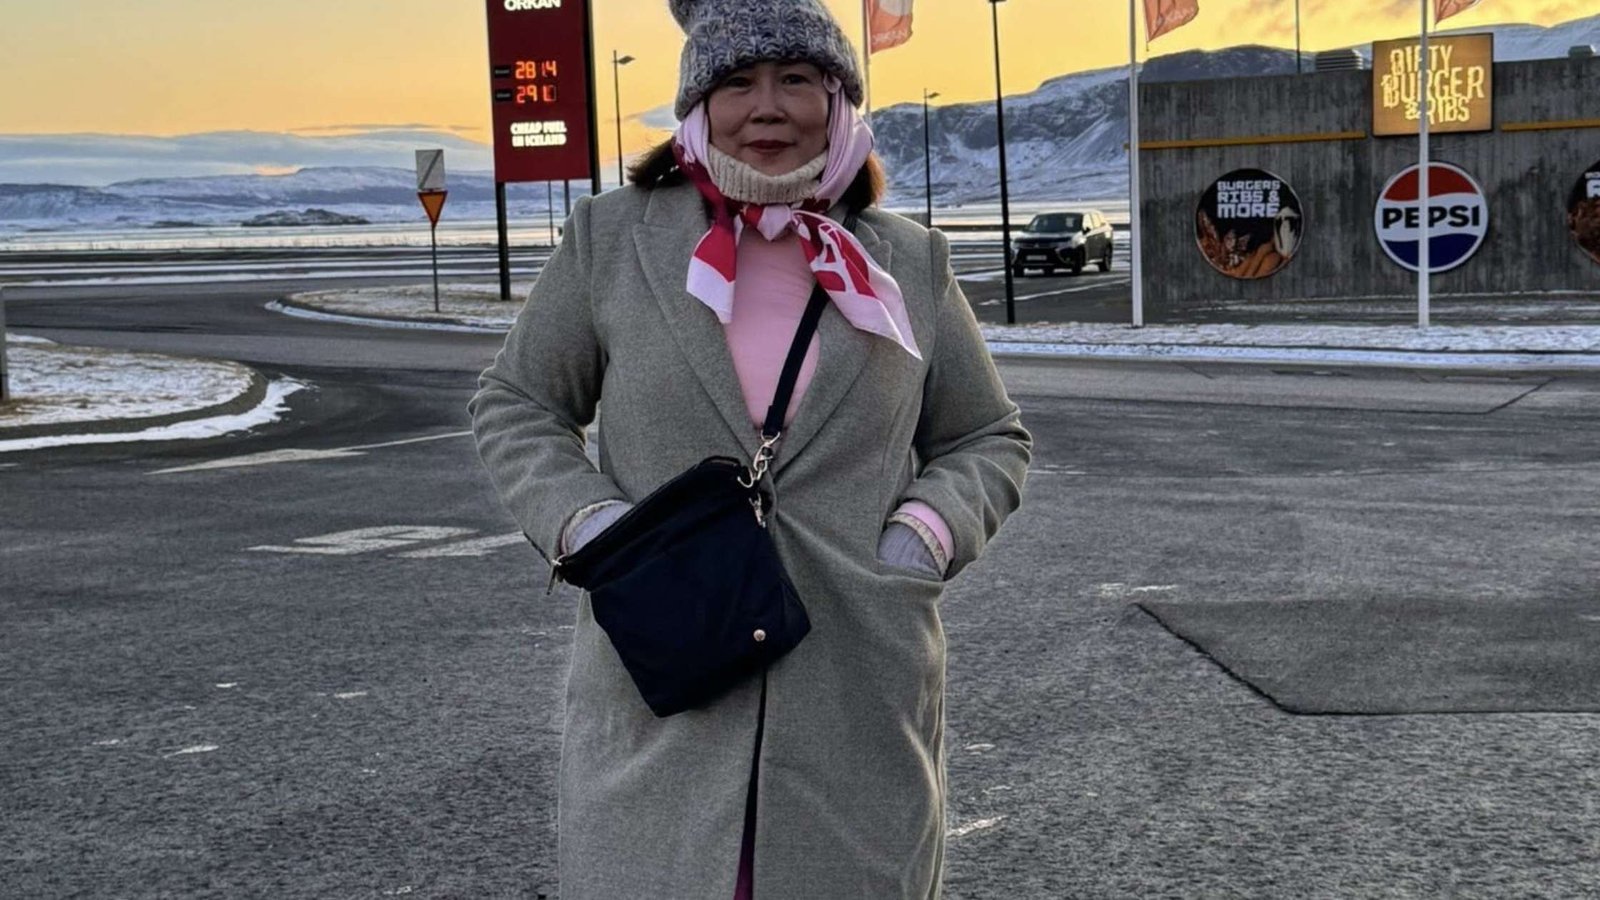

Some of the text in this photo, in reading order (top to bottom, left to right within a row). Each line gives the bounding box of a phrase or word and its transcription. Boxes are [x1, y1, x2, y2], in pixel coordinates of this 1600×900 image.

[504, 0, 561, 11] ORKAN
[1381, 66, 1485, 108] BURGER
[511, 121, 567, 134] CHEAP FUEL
[512, 134, 566, 147] IN ICELAND
[1217, 180, 1280, 191] BURGERS
[1217, 190, 1280, 203] RIBS &
[1217, 203, 1280, 218] MORE
[1382, 205, 1480, 229] PEPSI
